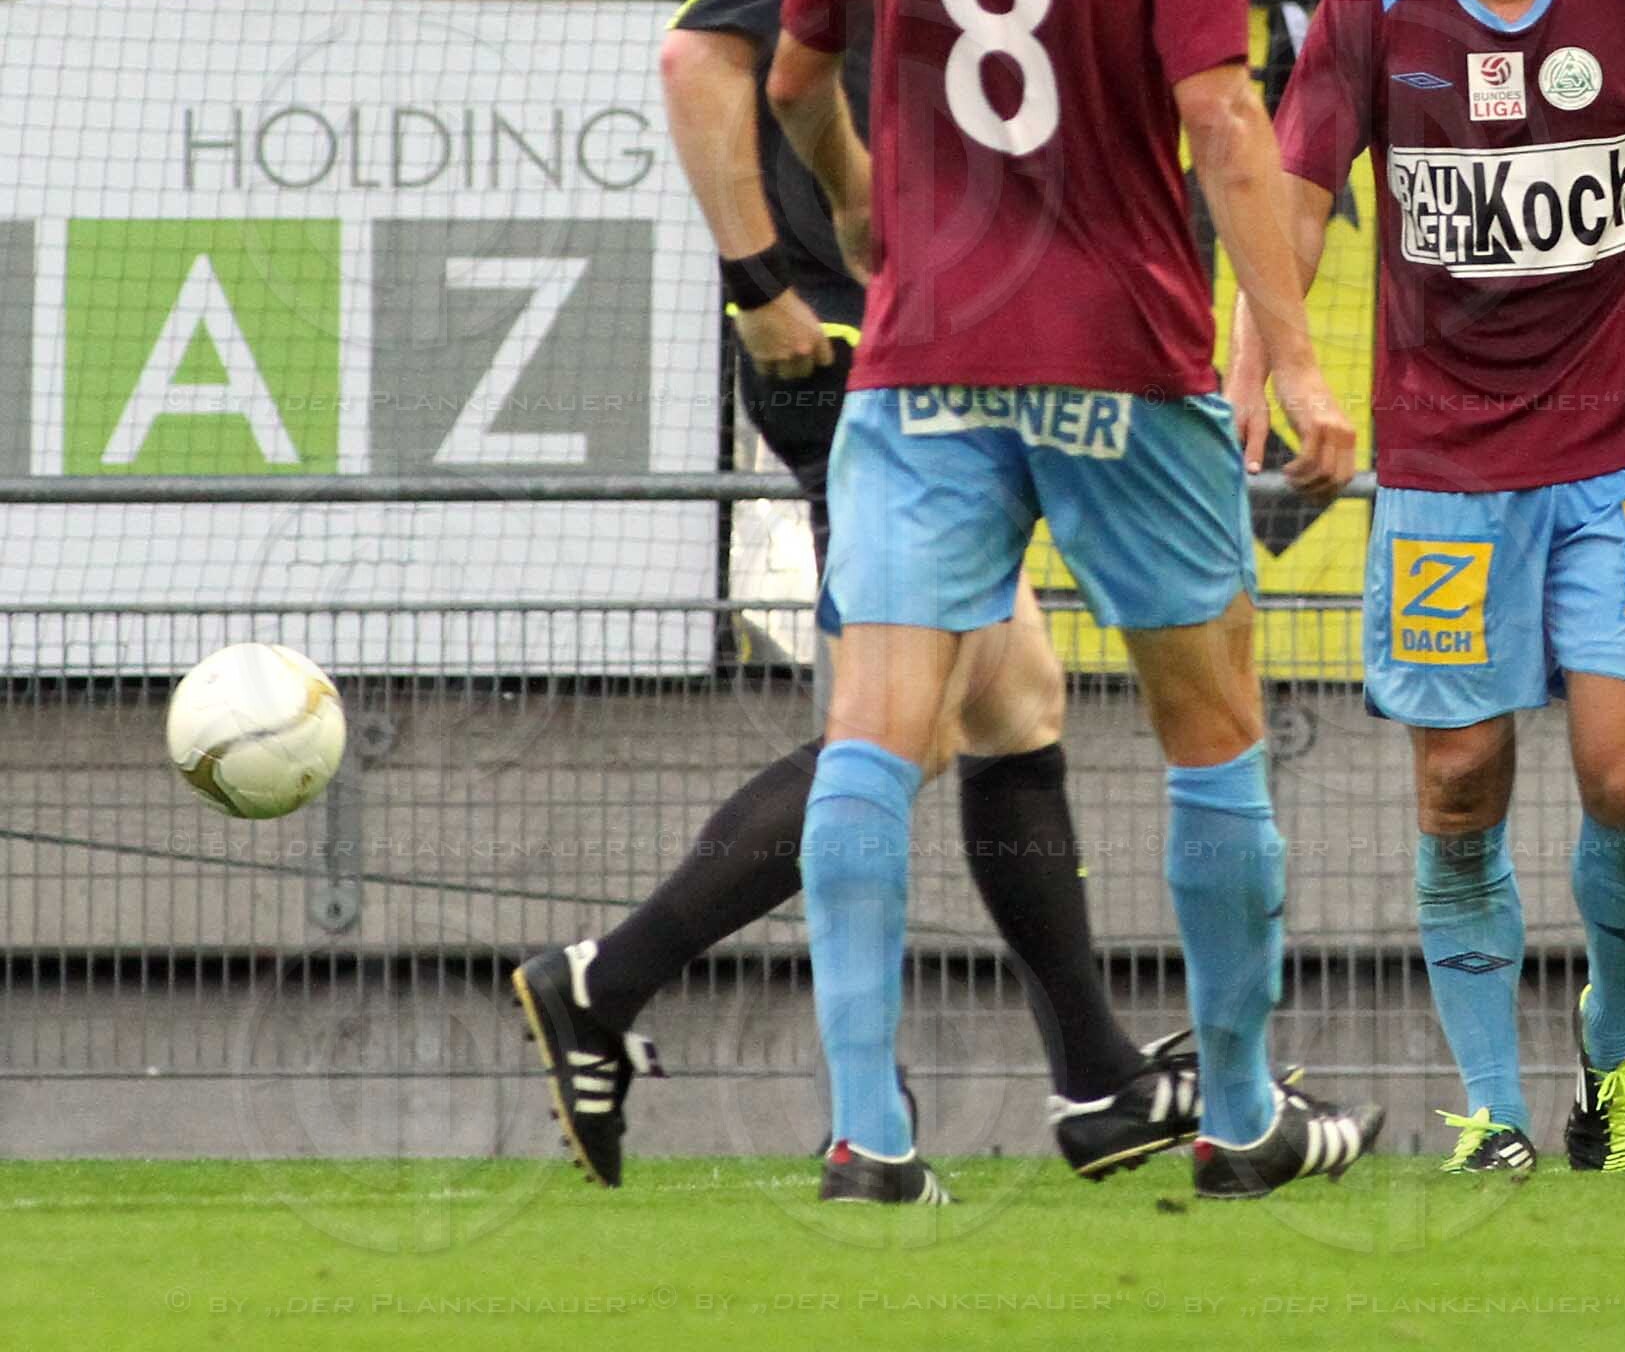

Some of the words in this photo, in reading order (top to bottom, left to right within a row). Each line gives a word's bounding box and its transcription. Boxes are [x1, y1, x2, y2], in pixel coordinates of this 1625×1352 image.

[1473, 90, 1522, 102] BUNDES
[1474, 102, 1524, 118] LIGA
[183, 107, 656, 191] HOLDING
[1394, 159, 1459, 215] BAU
[1415, 215, 1471, 264] ELT
[1401, 629, 1472, 653] DACH
